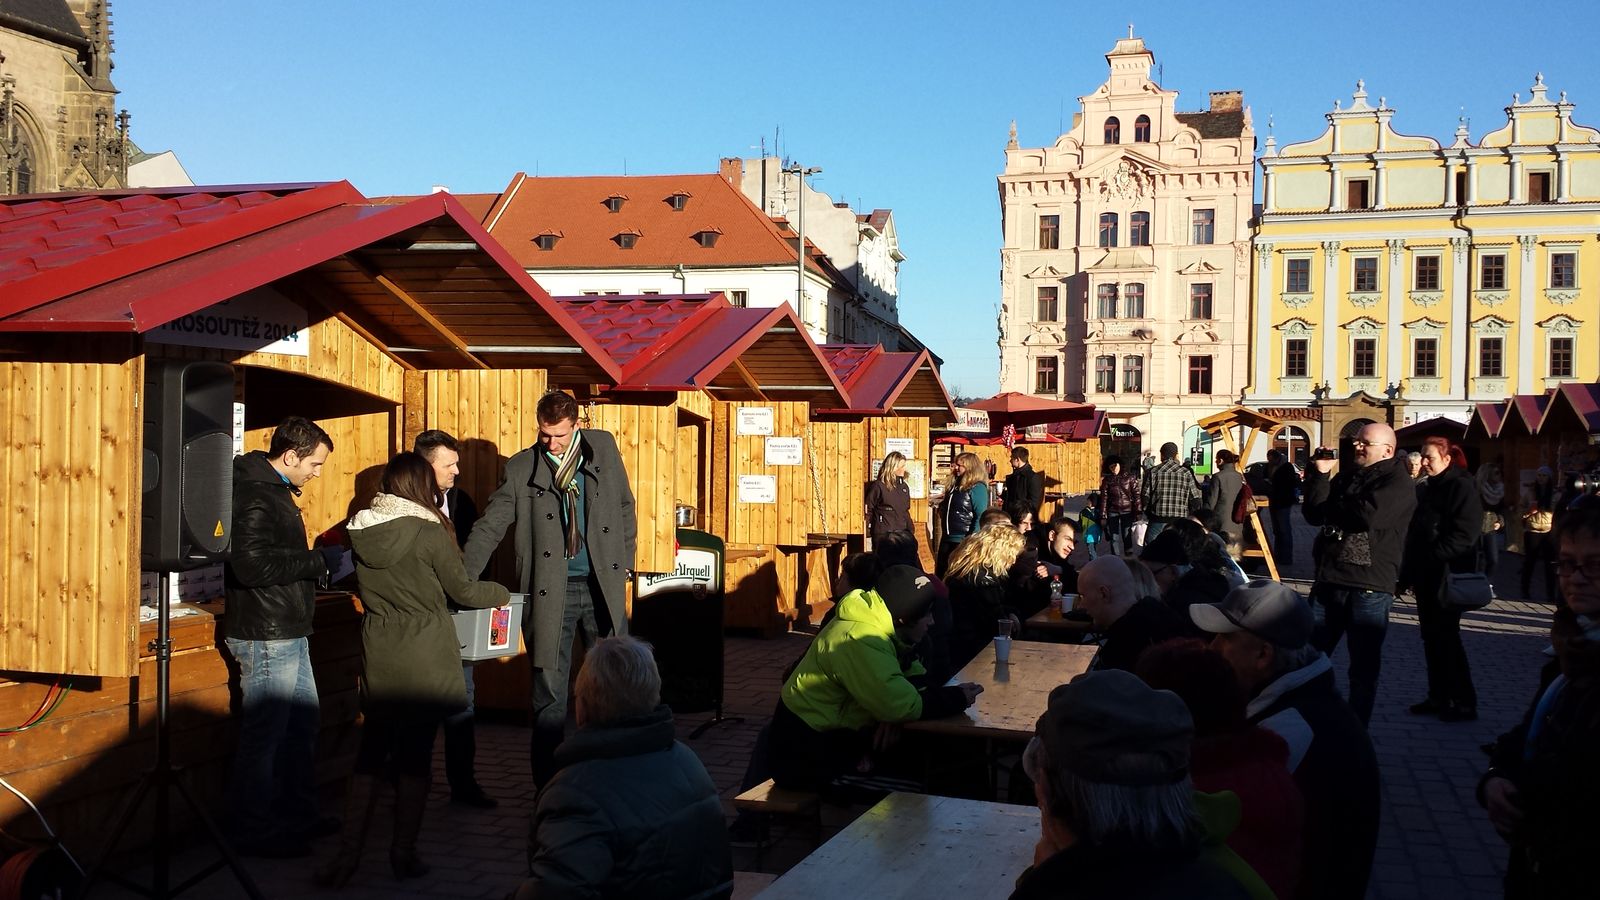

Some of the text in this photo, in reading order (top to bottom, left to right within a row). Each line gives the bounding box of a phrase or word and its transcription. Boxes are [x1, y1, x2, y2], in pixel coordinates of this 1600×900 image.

[161, 315, 299, 342] ROSOUTĚŽ 2014
[678, 562, 710, 581] Urquell
